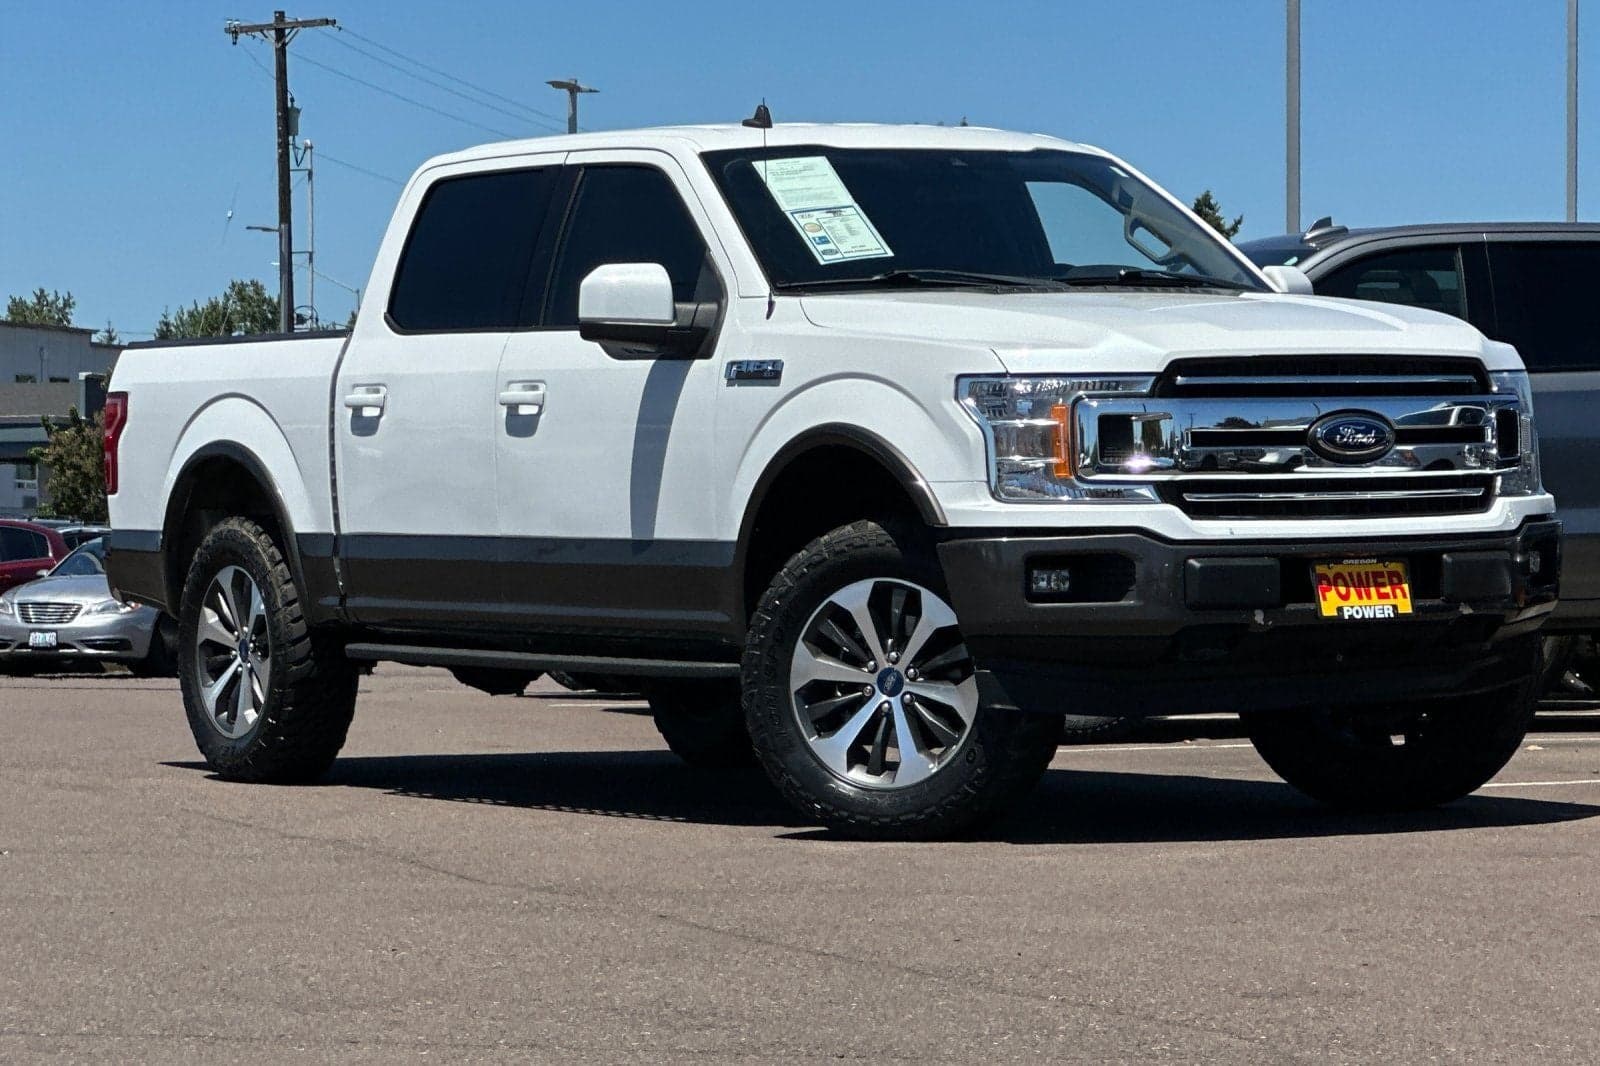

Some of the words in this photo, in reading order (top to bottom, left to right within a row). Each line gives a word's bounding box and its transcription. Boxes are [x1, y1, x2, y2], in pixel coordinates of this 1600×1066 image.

[1335, 424, 1376, 444] Ford
[1316, 571, 1408, 601] POWER
[1343, 605, 1394, 619] POWER
